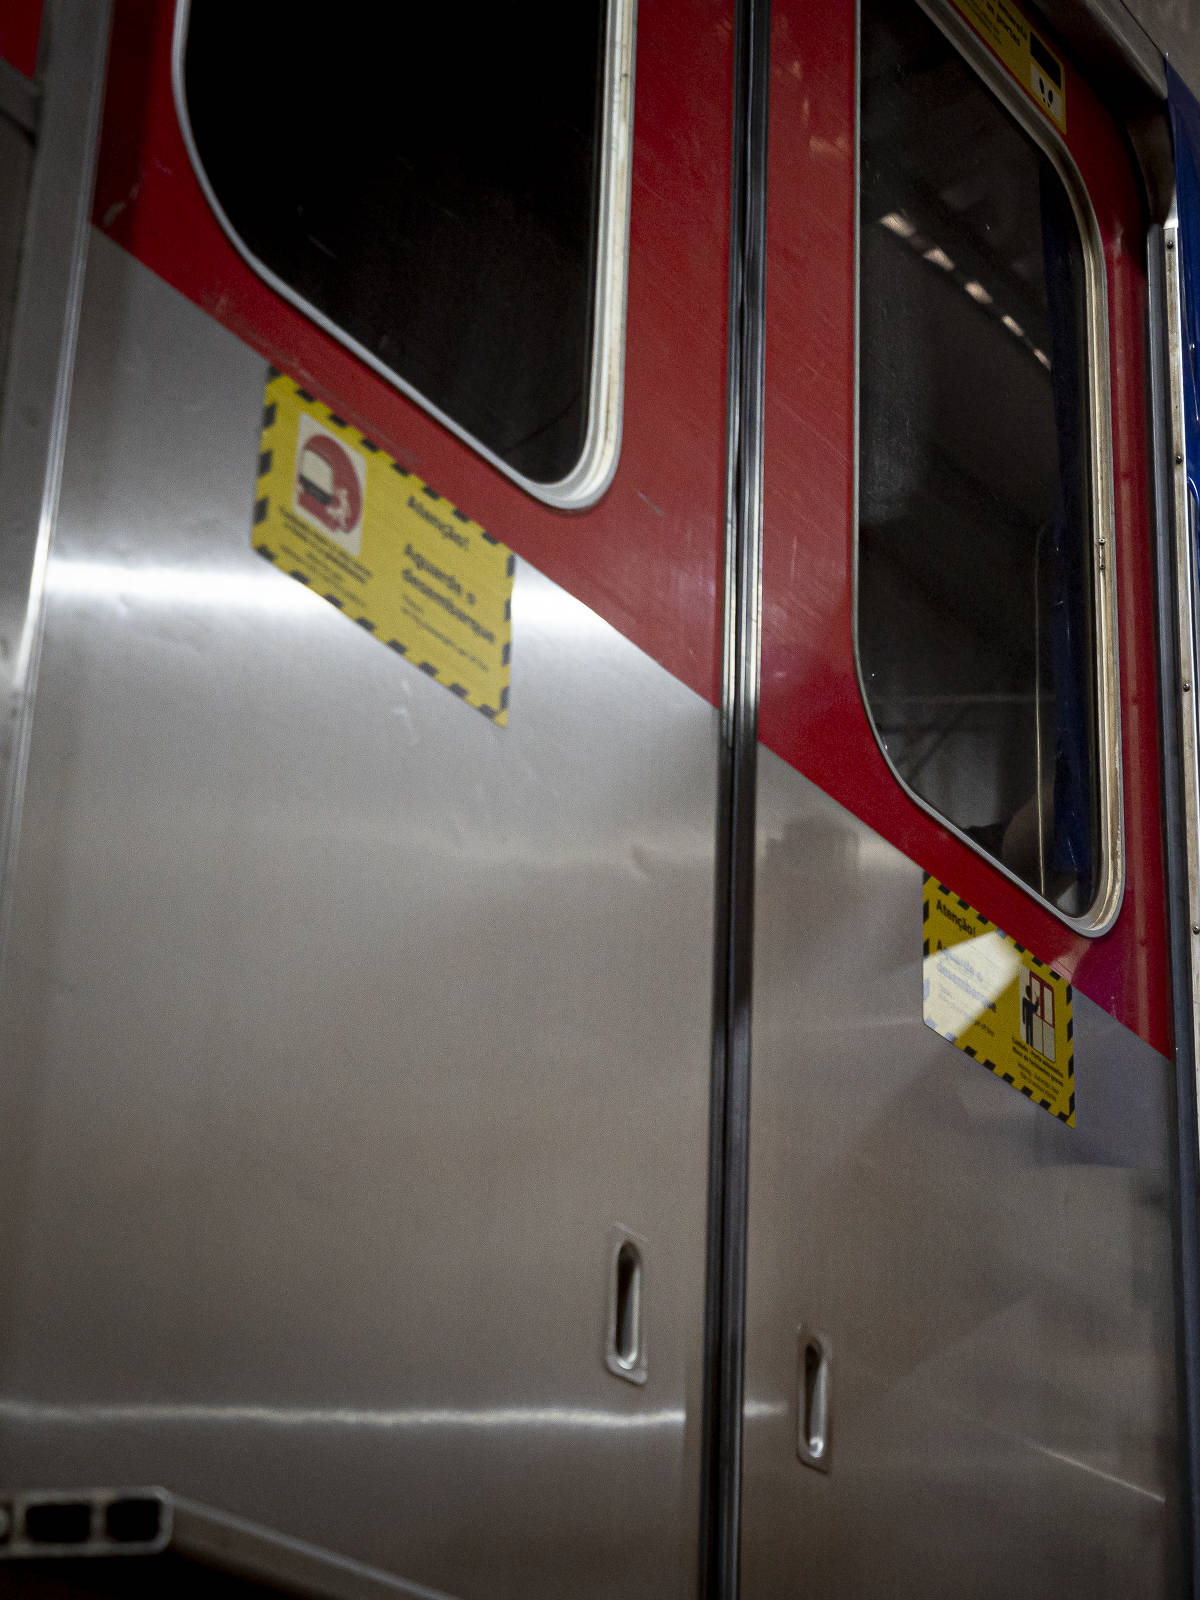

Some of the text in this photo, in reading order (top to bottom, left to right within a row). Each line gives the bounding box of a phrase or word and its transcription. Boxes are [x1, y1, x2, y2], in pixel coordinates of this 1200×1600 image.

[408, 496, 470, 550] Atenção!
[404, 544, 463, 597] Aguarde
[936, 900, 976, 937] Atenção!
